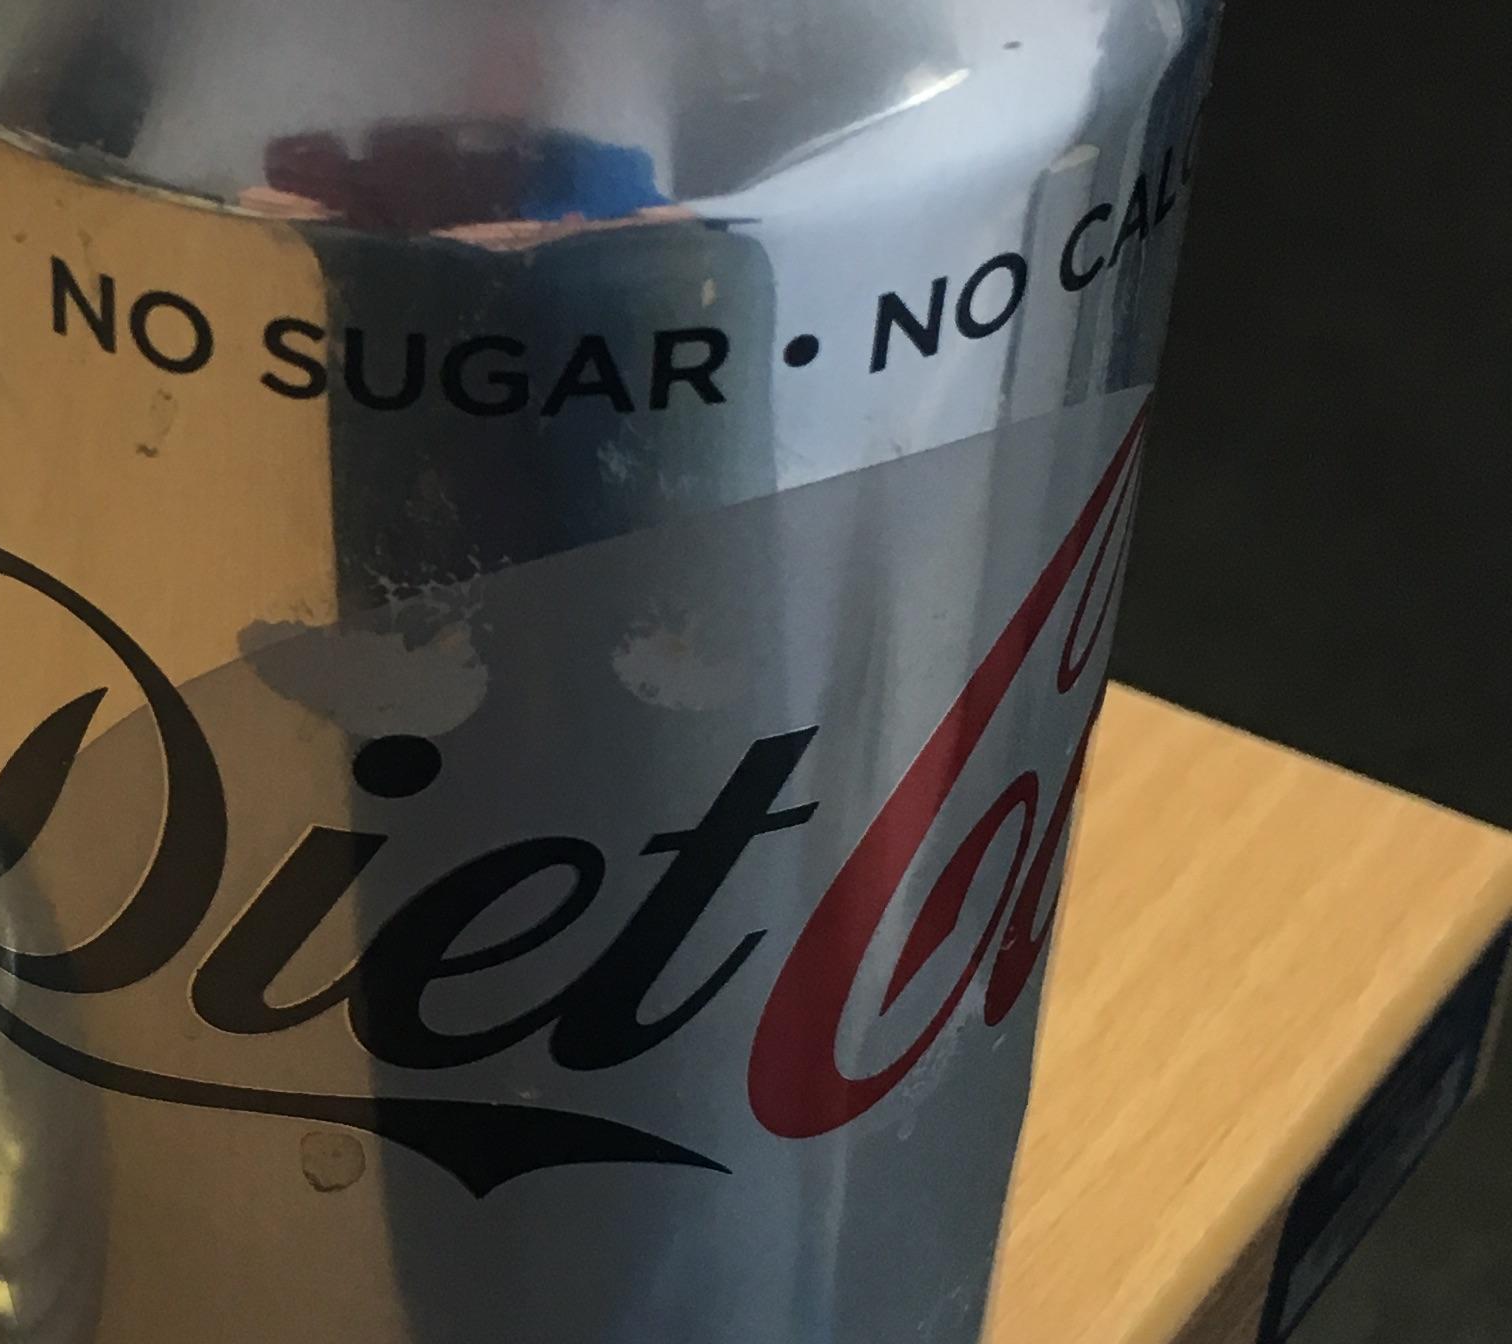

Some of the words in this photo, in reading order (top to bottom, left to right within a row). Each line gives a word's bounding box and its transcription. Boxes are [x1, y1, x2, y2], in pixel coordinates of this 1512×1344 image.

[48, 255, 216, 375] NO
[258, 316, 732, 420] SUGAR
[868, 249, 1029, 376] NO
[1058, 124, 1192, 294] CAL
